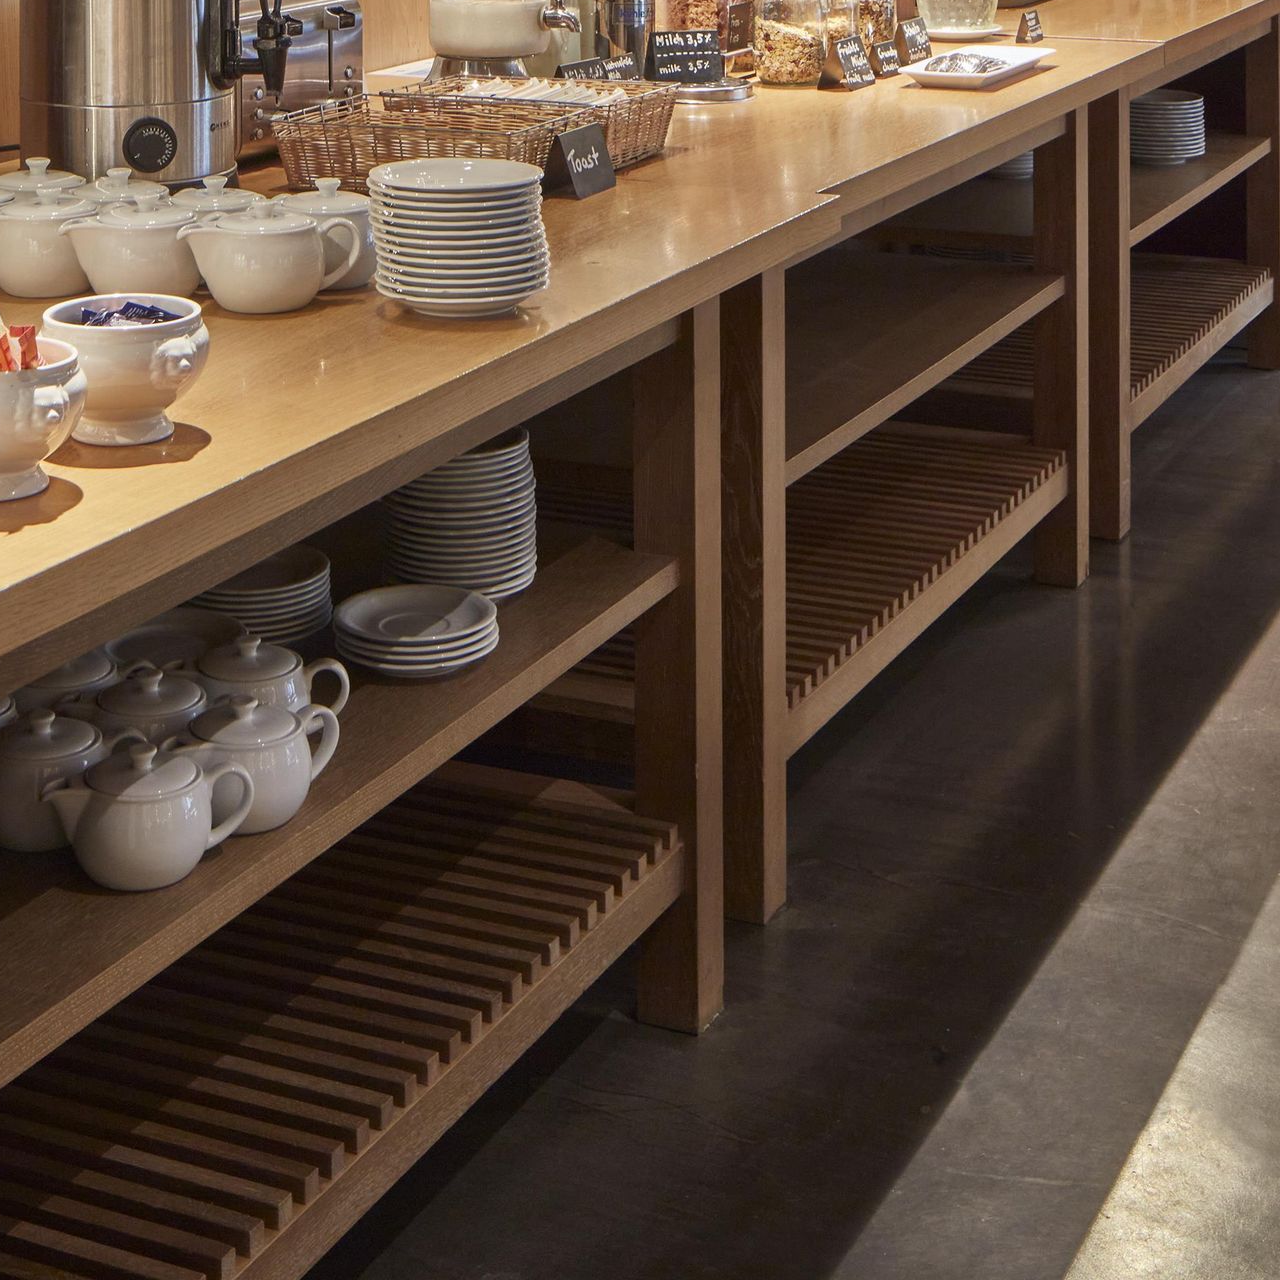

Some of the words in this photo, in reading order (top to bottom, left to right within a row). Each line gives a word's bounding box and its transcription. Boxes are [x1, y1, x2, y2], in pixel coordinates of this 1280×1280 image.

[655, 34, 684, 48] Milch
[687, 33, 712, 47] 3,5%
[659, 64, 682, 74] milk
[688, 60, 710, 74] 3,5%
[567, 145, 599, 173] Toast
